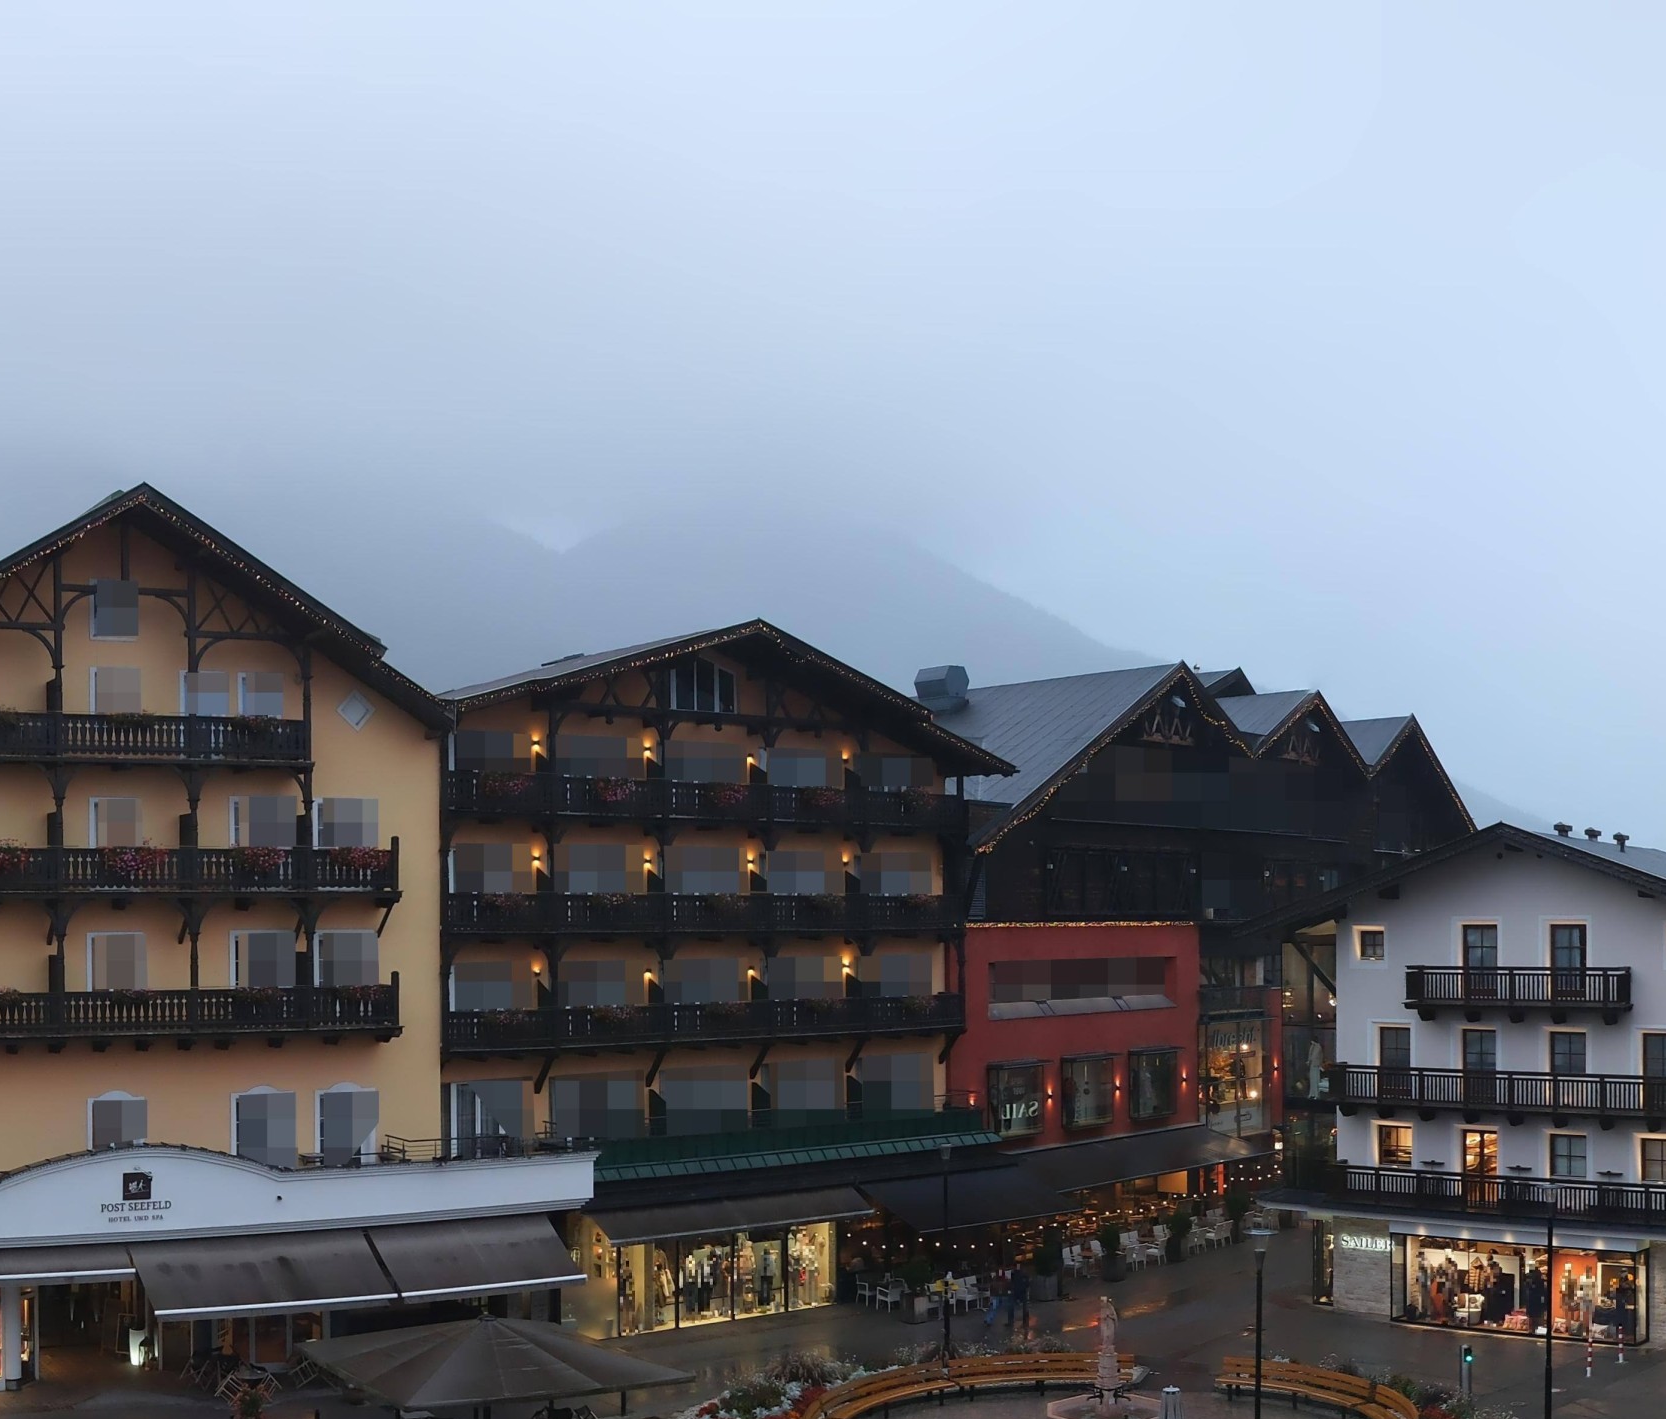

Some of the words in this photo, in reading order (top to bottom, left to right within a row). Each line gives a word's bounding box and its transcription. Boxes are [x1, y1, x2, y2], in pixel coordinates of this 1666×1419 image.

[100, 1202, 126, 1213] POST
[128, 1200, 172, 1212] SEEFELD
[1341, 1234, 1395, 1252] SAILER
